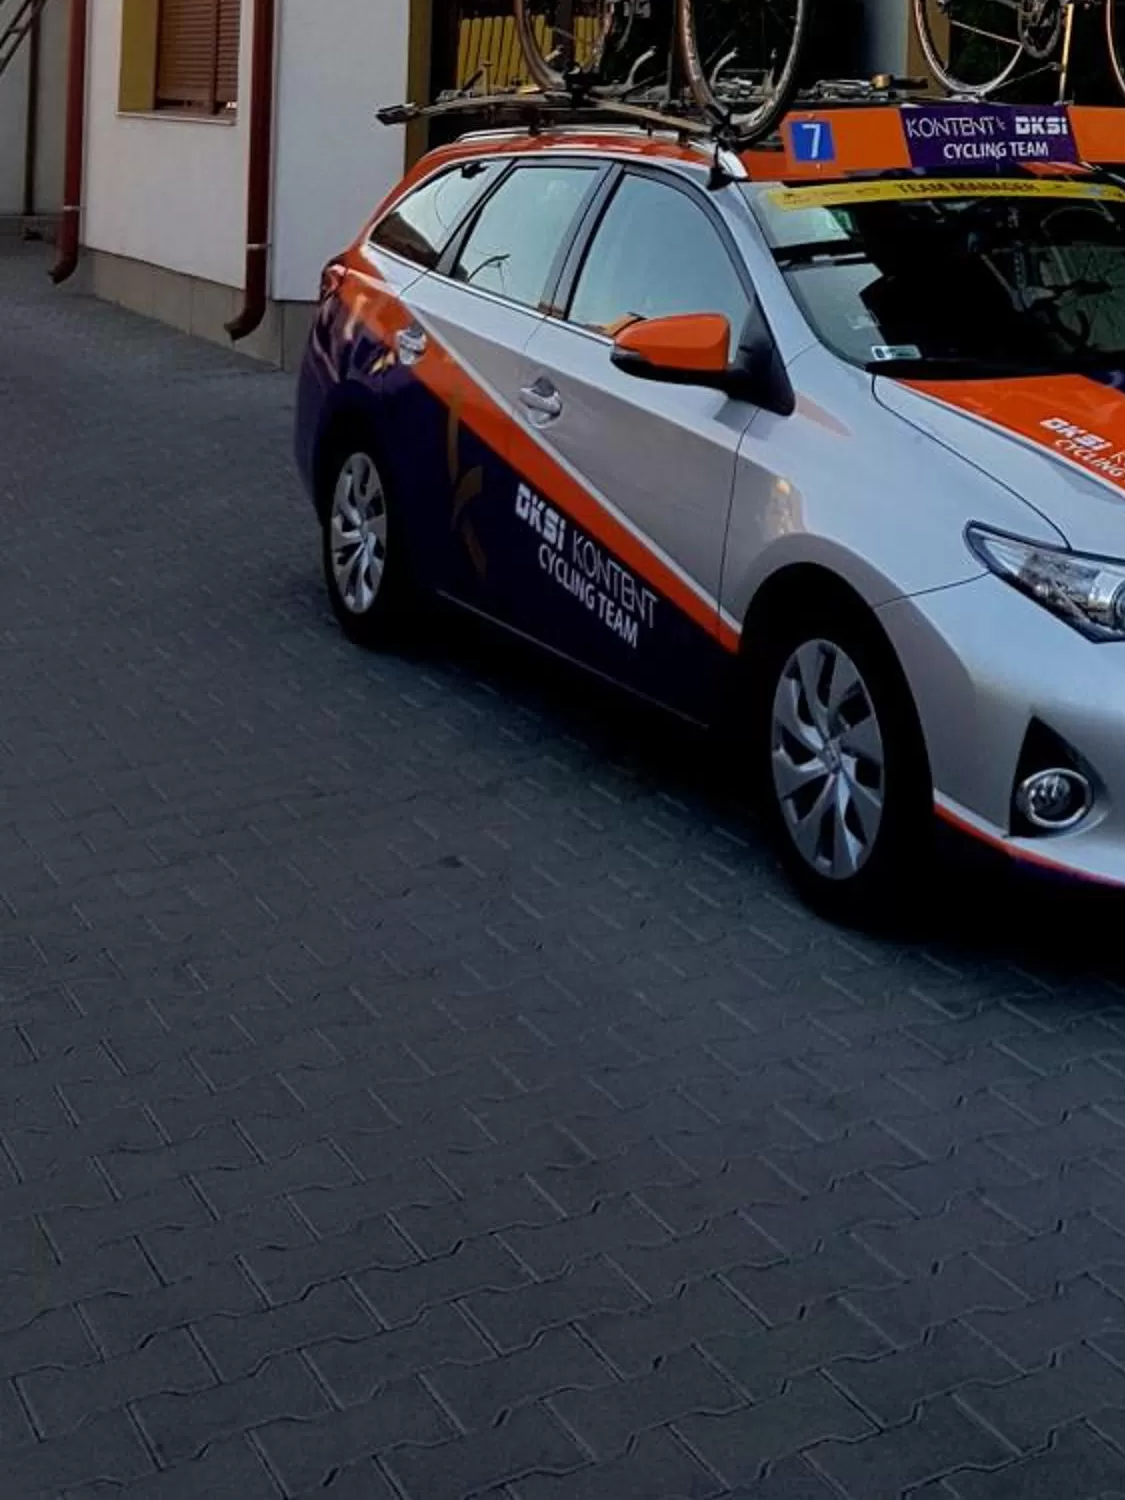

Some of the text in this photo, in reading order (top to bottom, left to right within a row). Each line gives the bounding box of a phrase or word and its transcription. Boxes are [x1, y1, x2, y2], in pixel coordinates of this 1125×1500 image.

[801, 123, 822, 160] 7
[905, 116, 995, 138] KONTENT
[943, 141, 1050, 160] CYCLING TEAM
[895, 182, 949, 195] TEAM
[950, 181, 1041, 194] MANAGER
[572, 529, 660, 629] KONTENT
[538, 543, 639, 650] CYCLING TEAM
